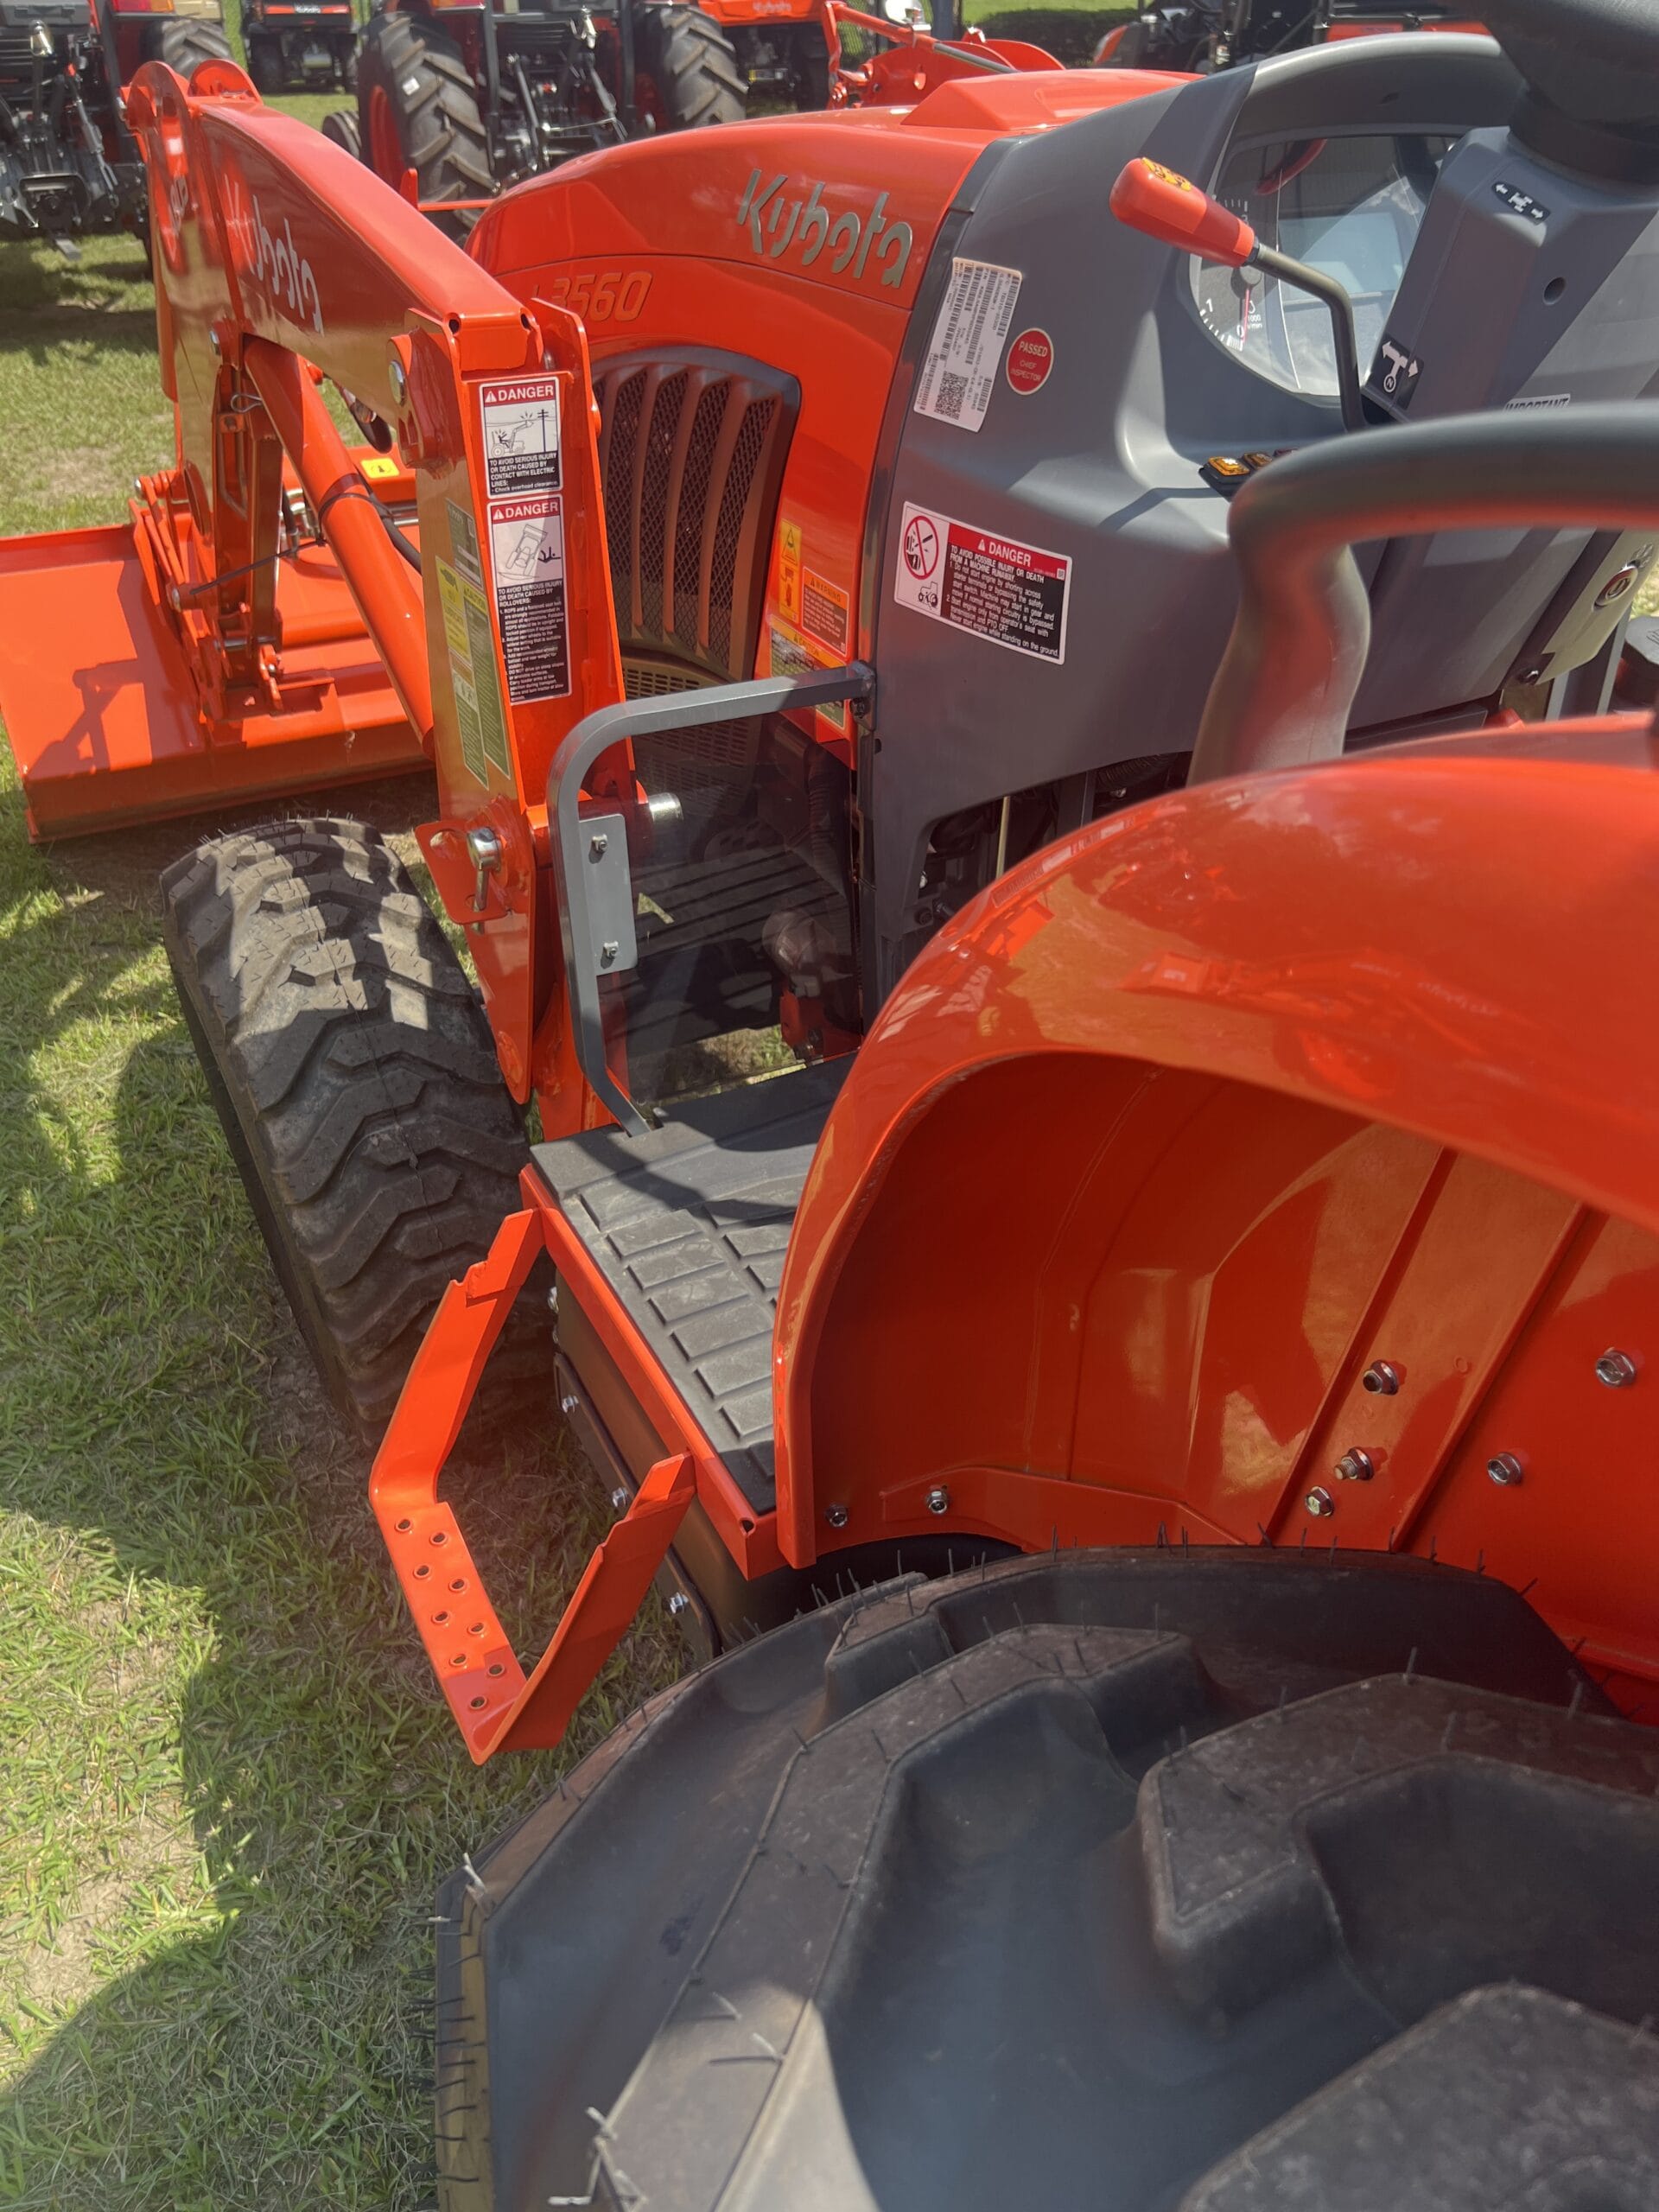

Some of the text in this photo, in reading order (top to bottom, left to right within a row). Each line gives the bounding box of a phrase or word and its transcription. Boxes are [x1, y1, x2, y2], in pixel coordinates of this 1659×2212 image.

[738, 168, 912, 289] Kubota
[224, 173, 325, 337] Kubota
[1206, 298, 1213, 313] 1
[1236, 324, 1245, 338] 0
[1019, 340, 1048, 358] PASSED
[1020, 359, 1037, 370] CHIEF
[1010, 368, 1042, 381] INSPECTOR
[499, 385, 554, 402] DANGER
[515, 454, 537, 463] SERIOUS
[518, 462, 539, 471] CAUSED
[491, 467, 555, 480] CONTACT WITH ELECTRIC
[505, 501, 558, 519] DANGER
[950, 552, 963, 563] FROM
[969, 560, 990, 574] MACHINE
[950, 544, 957, 553] TO
[959, 548, 973, 559] AVOID
[974, 553, 995, 567] POSSIBLE
[997, 562, 1014, 573] INJURY
[1016, 568, 1024, 576] OR
[1026, 571, 1044, 583] DEATH
[988, 542, 1032, 568] DANGER
[522, 582, 543, 591] SERIOUS
[954, 562, 961, 570] Do
[969, 569, 980, 578] start
[981, 573, 995, 585] engine
[996, 578, 1002, 588] by
[1004, 582, 1023, 594] shorting
[1024, 588, 1040, 600] across
[524, 588, 545, 597] CAUSED
[816, 582, 841, 602] WARNING
[987, 619, 997, 629] PTO
[973, 622, 988, 634] engine
[988, 627, 999, 638] while
[1001, 632, 1020, 646] standing
[1030, 641, 1039, 652] the
